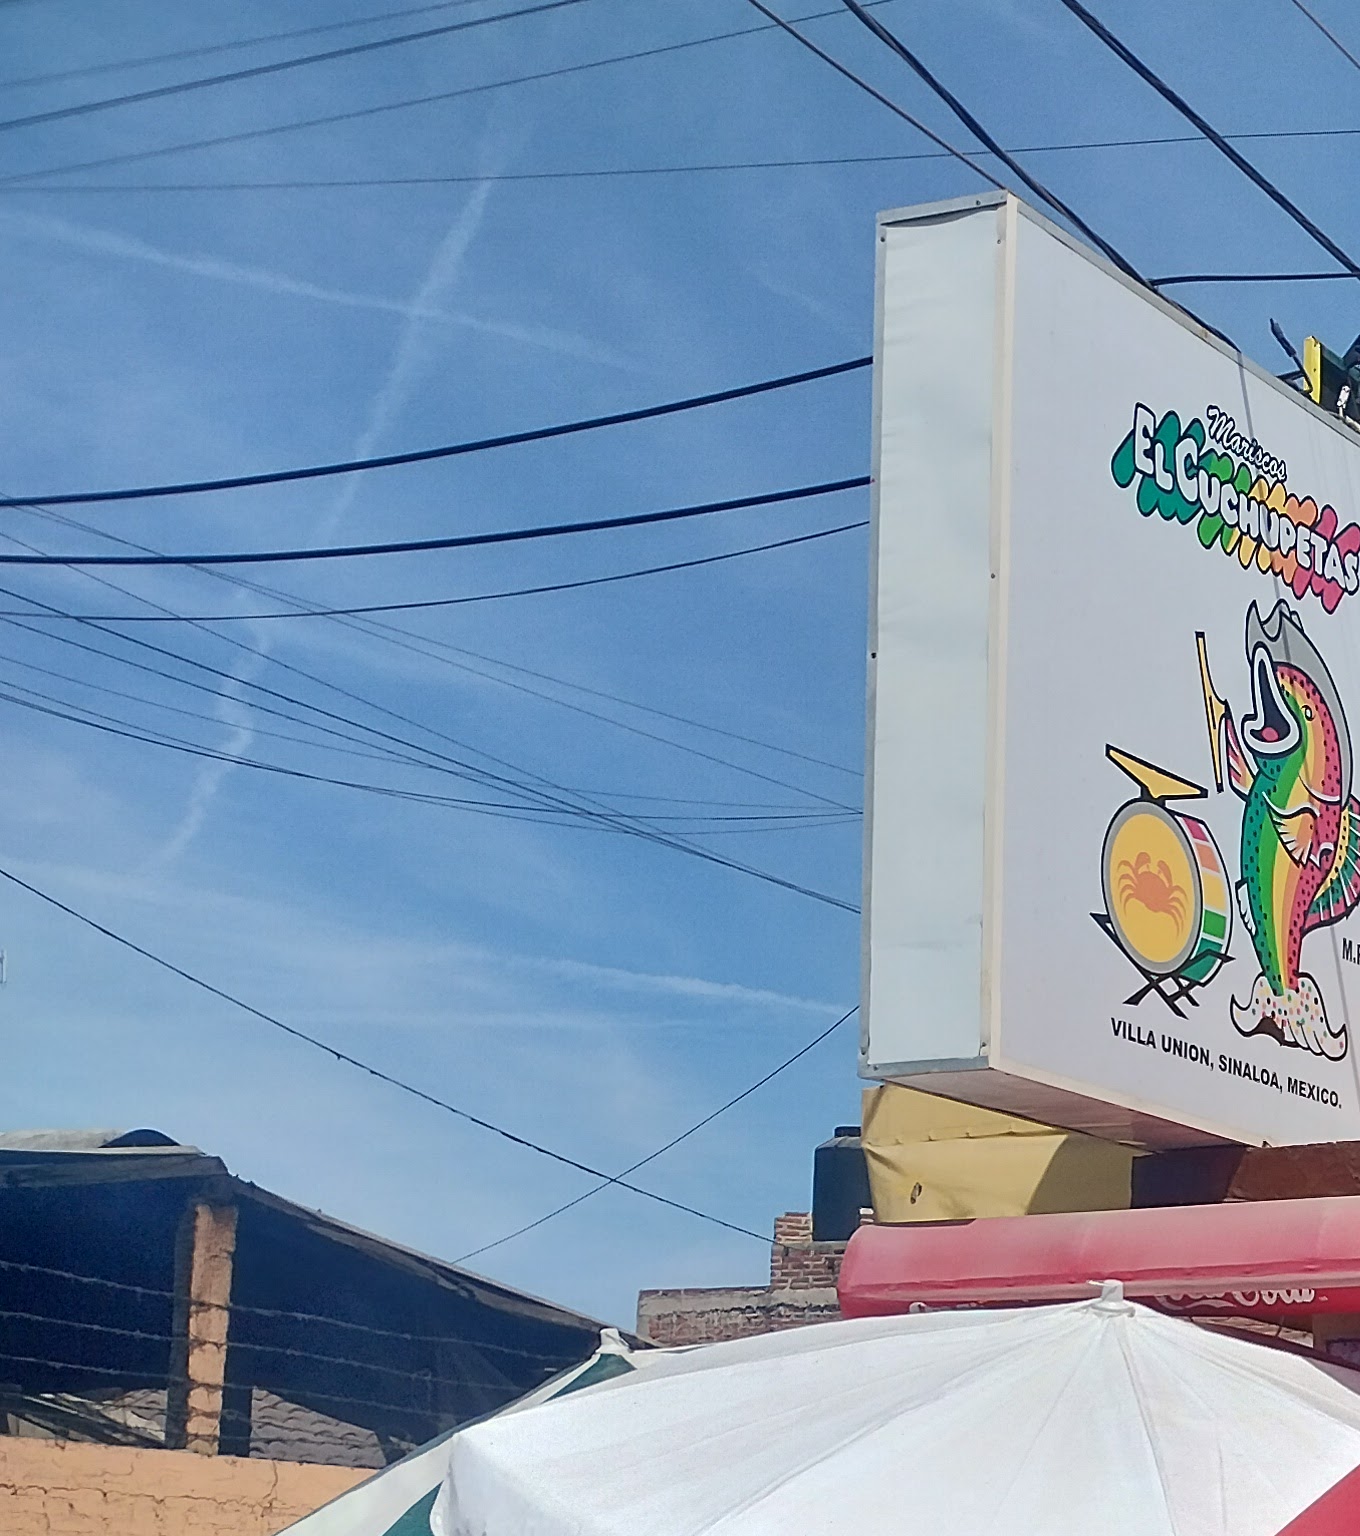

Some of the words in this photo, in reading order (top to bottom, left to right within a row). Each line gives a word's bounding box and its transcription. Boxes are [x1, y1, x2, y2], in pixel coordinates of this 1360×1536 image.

[1207, 405, 1287, 482] Mariscos
[1134, 402, 1175, 493] EL
[1174, 436, 1360, 595] CUCHUPETAS
[1111, 1017, 1156, 1049] VILLA
[1161, 1032, 1214, 1071] UNION,
[1218, 1054, 1283, 1094] SINALOA,
[1287, 1076, 1342, 1109] MEXICO.
